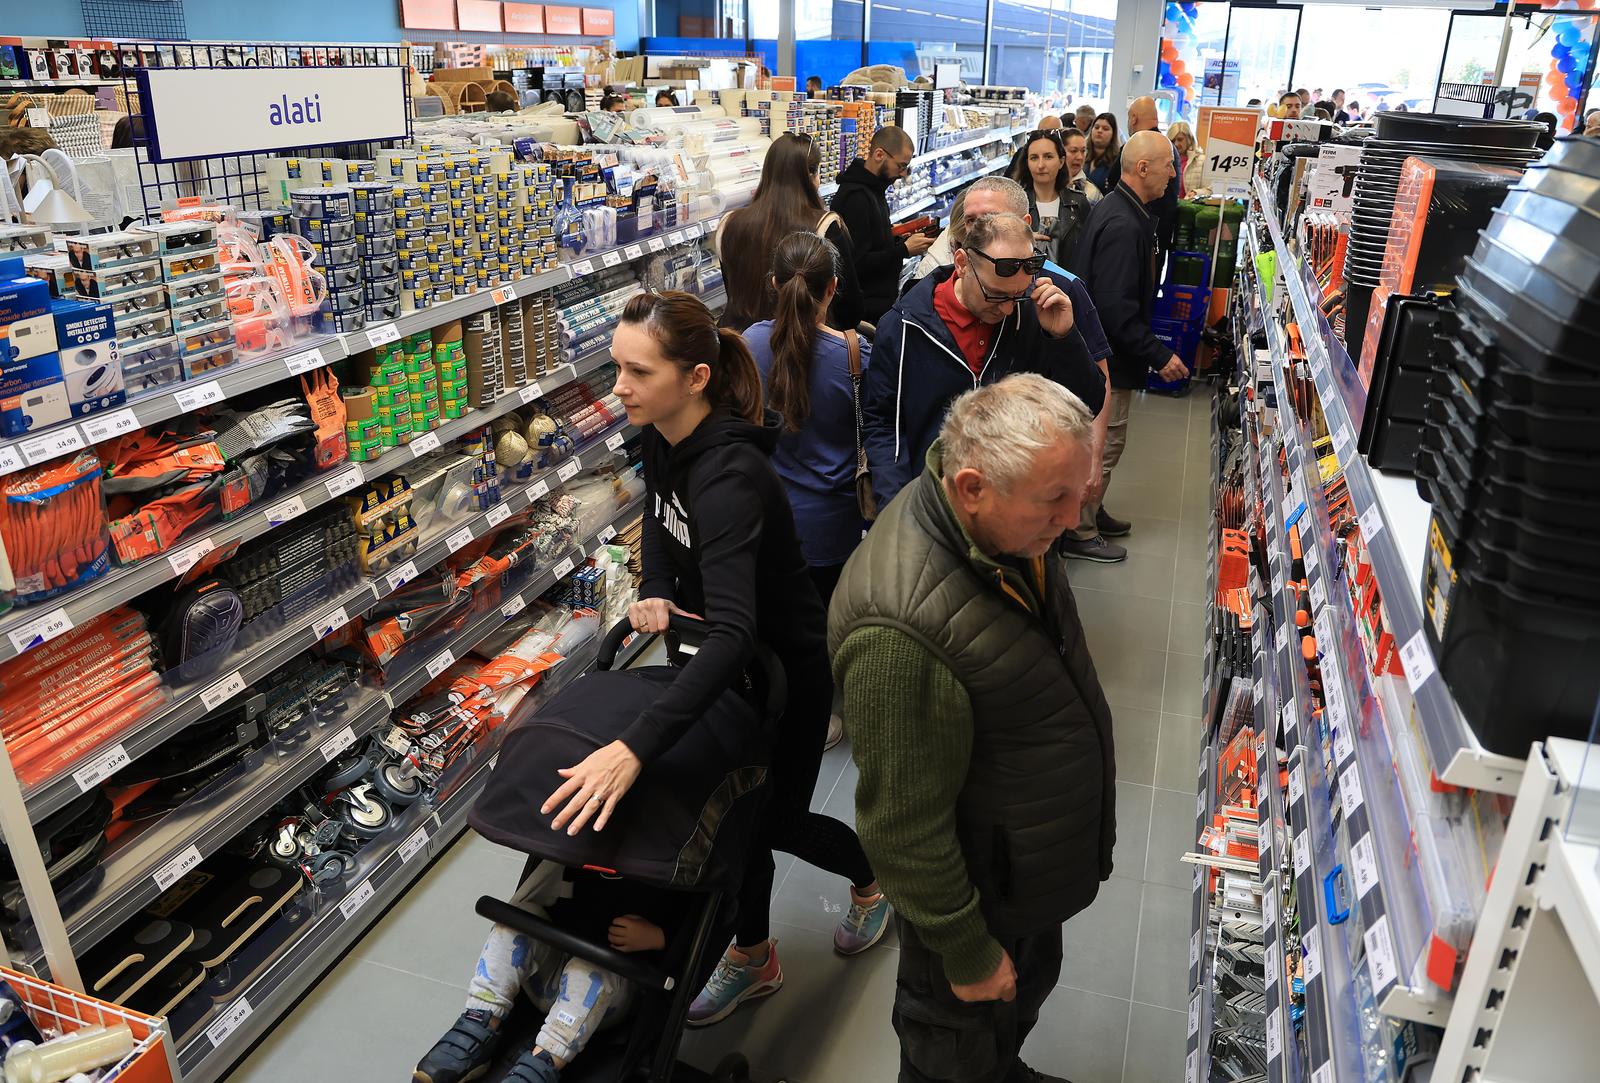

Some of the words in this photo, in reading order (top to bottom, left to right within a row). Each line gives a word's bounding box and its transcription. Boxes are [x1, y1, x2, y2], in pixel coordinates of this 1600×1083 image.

[269, 94, 321, 126] alati
[66, 321, 84, 331] SMOKE
[84, 316, 106, 326] DETECTOR
[66, 324, 98, 337] INSTALLATION
[98, 322, 108, 330] SET
[203, 392, 216, 400] 1.89
[116, 418, 131, 430] 0.99
[57, 438, 77, 450] 14.99
[0, 458, 14, 469] .95
[288, 506, 299, 516] 2.99
[48, 620, 63, 632] 8.99
[49, 636, 69, 651] WORK
[56, 661, 80, 677] WORK
[80, 642, 112, 665] TROUSERS
[228, 681, 240, 692] 6.49
[108, 754, 126, 770] 13.49
